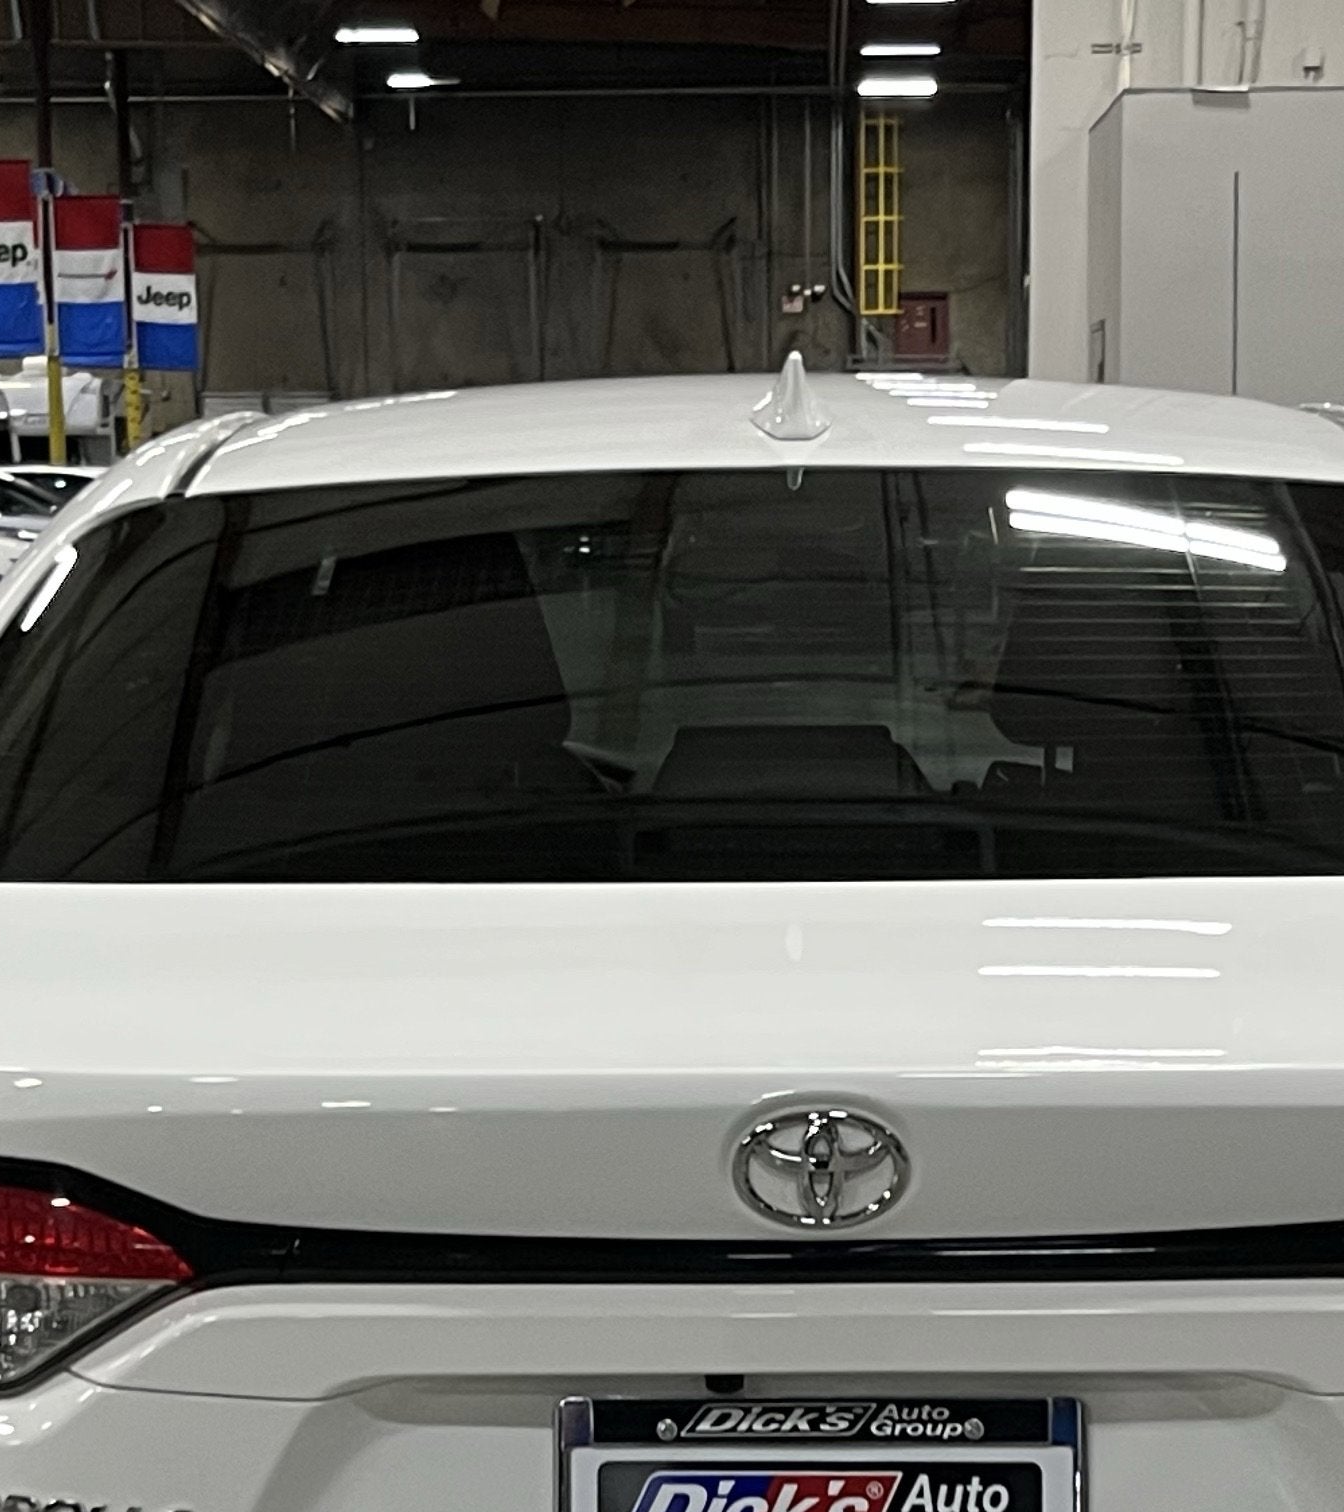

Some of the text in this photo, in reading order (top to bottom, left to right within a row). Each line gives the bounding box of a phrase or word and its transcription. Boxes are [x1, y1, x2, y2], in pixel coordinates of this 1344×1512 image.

[137, 286, 191, 310] Jeep
[877, 1403, 950, 1420] Auto
[870, 1419, 964, 1440] Group
